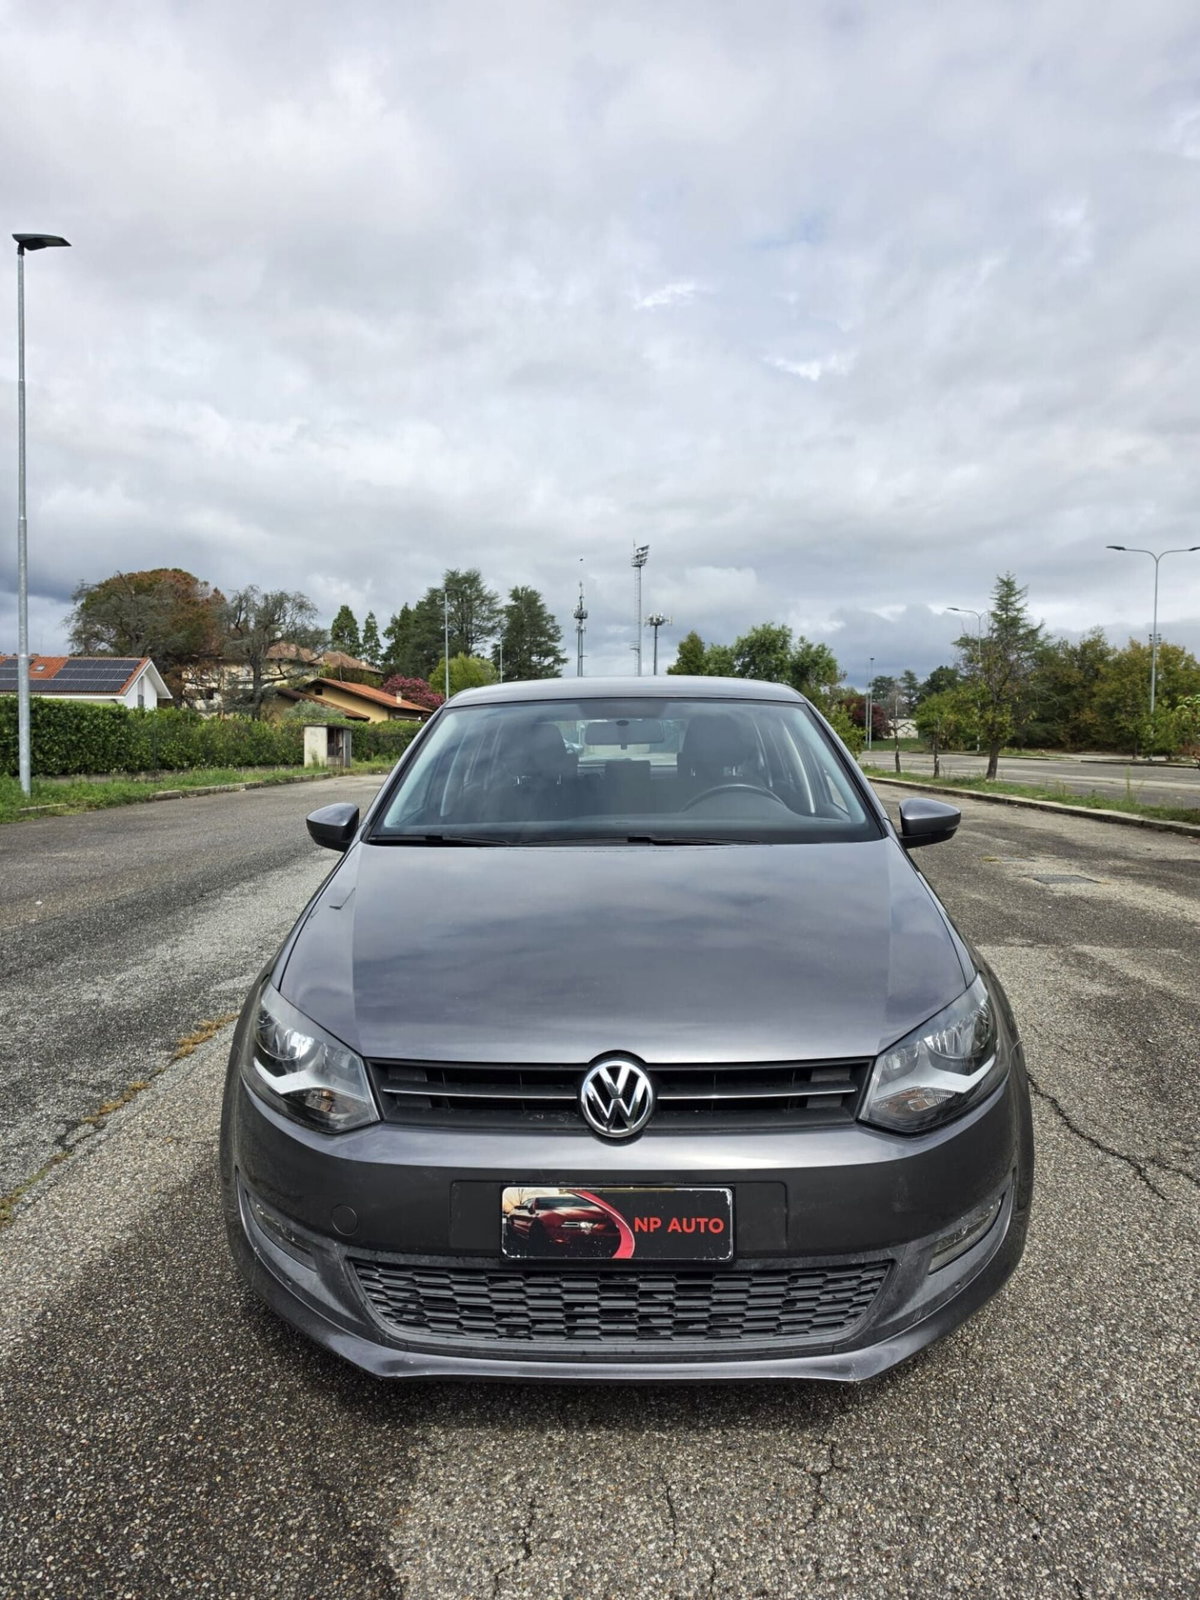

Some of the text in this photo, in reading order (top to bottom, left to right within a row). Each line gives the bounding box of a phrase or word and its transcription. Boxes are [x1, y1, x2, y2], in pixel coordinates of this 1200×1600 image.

[582, 1062, 650, 1134] VW
[634, 1217, 725, 1234] NP AUTO
